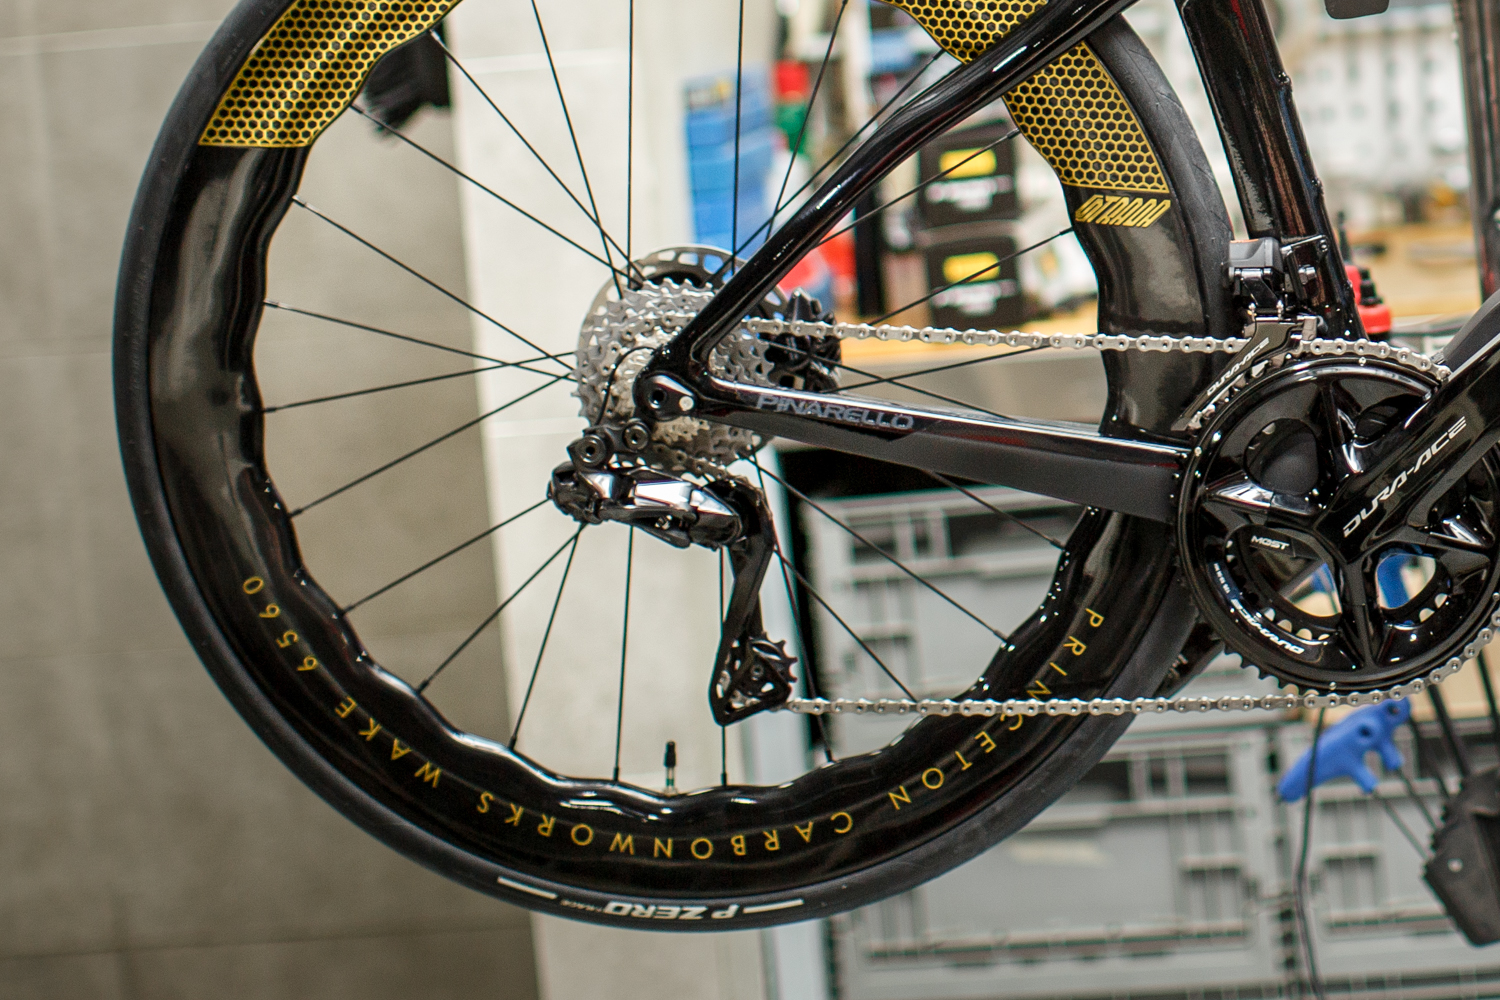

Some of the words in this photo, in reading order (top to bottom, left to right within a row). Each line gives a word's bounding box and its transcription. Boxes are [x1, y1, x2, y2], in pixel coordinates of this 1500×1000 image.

[1075, 194, 1171, 229] STRADA
[1207, 337, 1270, 397] DURA-ACE
[756, 393, 914, 431] PINARELLO
[1342, 416, 1467, 539] DURA-ACE
[242, 576, 319, 672] 6560
[888, 607, 1105, 811] PRINCETON
[335, 696, 442, 788] WAKE
[476, 790, 853, 860] CARBONWORKS
[603, 900, 708, 920] ZERO
[711, 904, 740, 920] P
